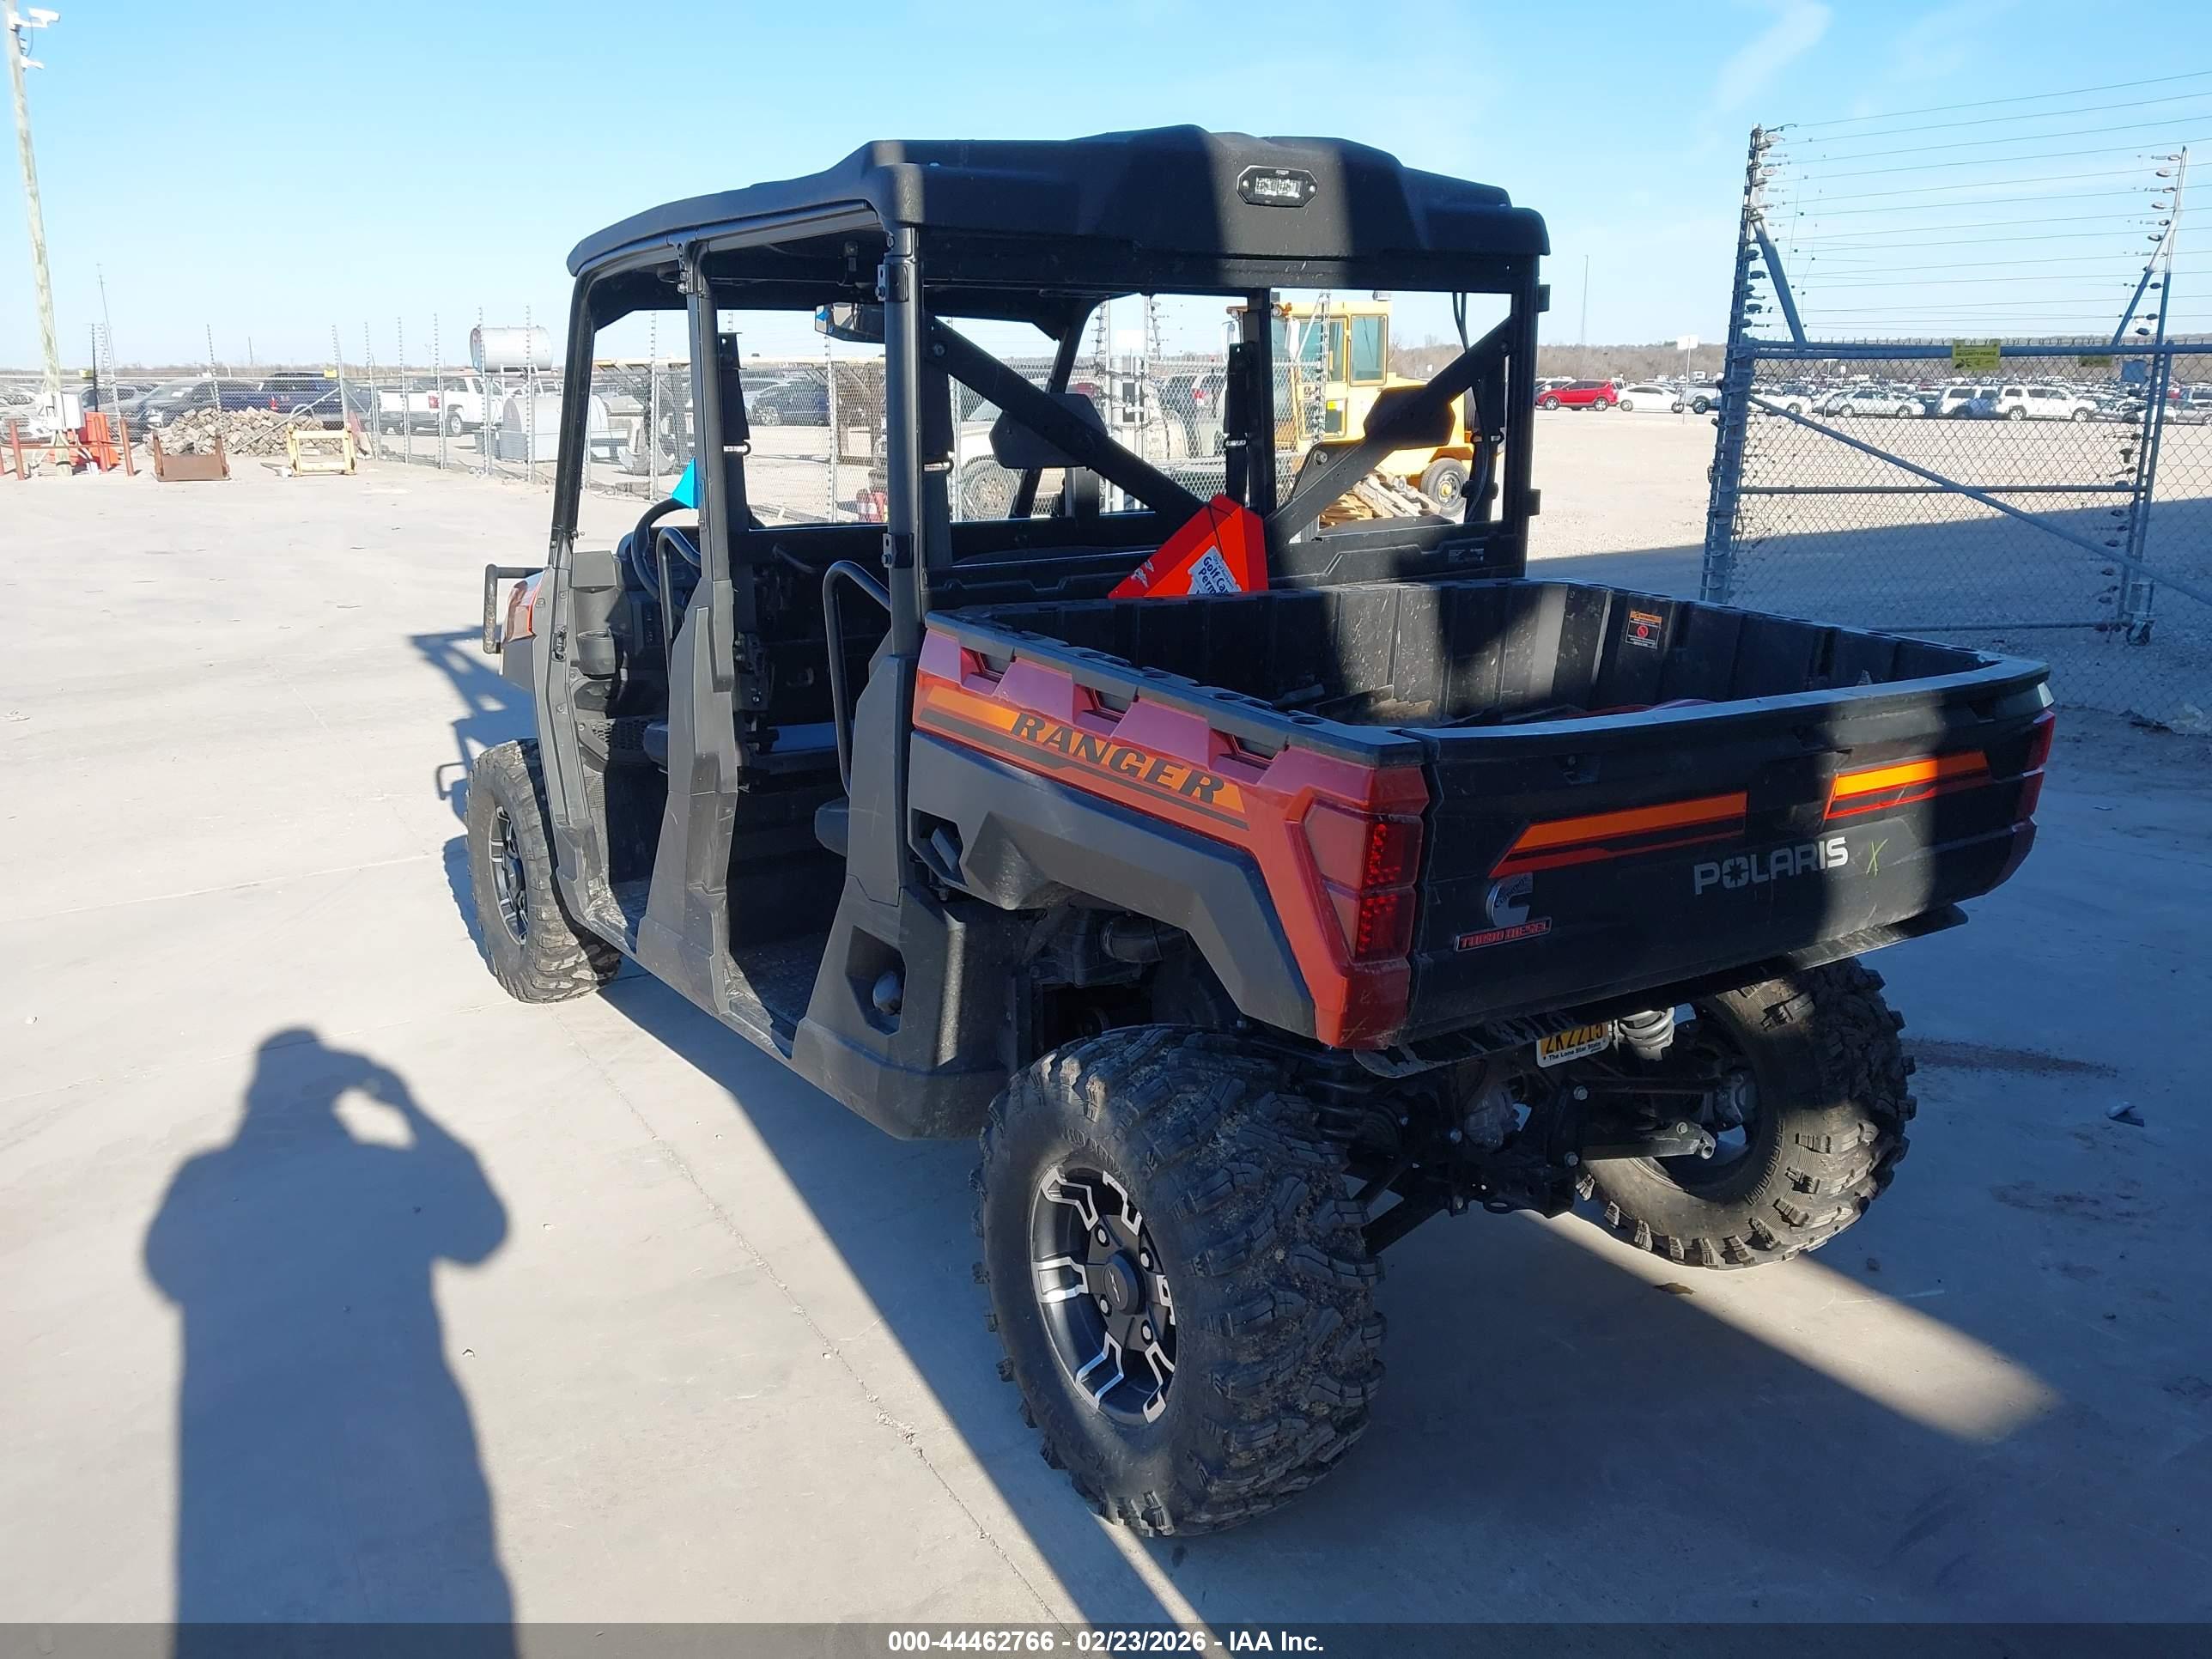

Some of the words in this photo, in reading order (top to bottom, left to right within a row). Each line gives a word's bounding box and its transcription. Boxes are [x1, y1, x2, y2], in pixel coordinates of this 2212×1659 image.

[1203, 556, 1220, 580] Golf
[1011, 712, 1224, 804] RANGER
[1693, 836, 1849, 895] POLARIS
[1460, 930, 1504, 948] TURBO
[1504, 920, 1549, 939] DIESEL
[1548, 1054, 1559, 1062] The
[1560, 1048, 1575, 1058] Lone
